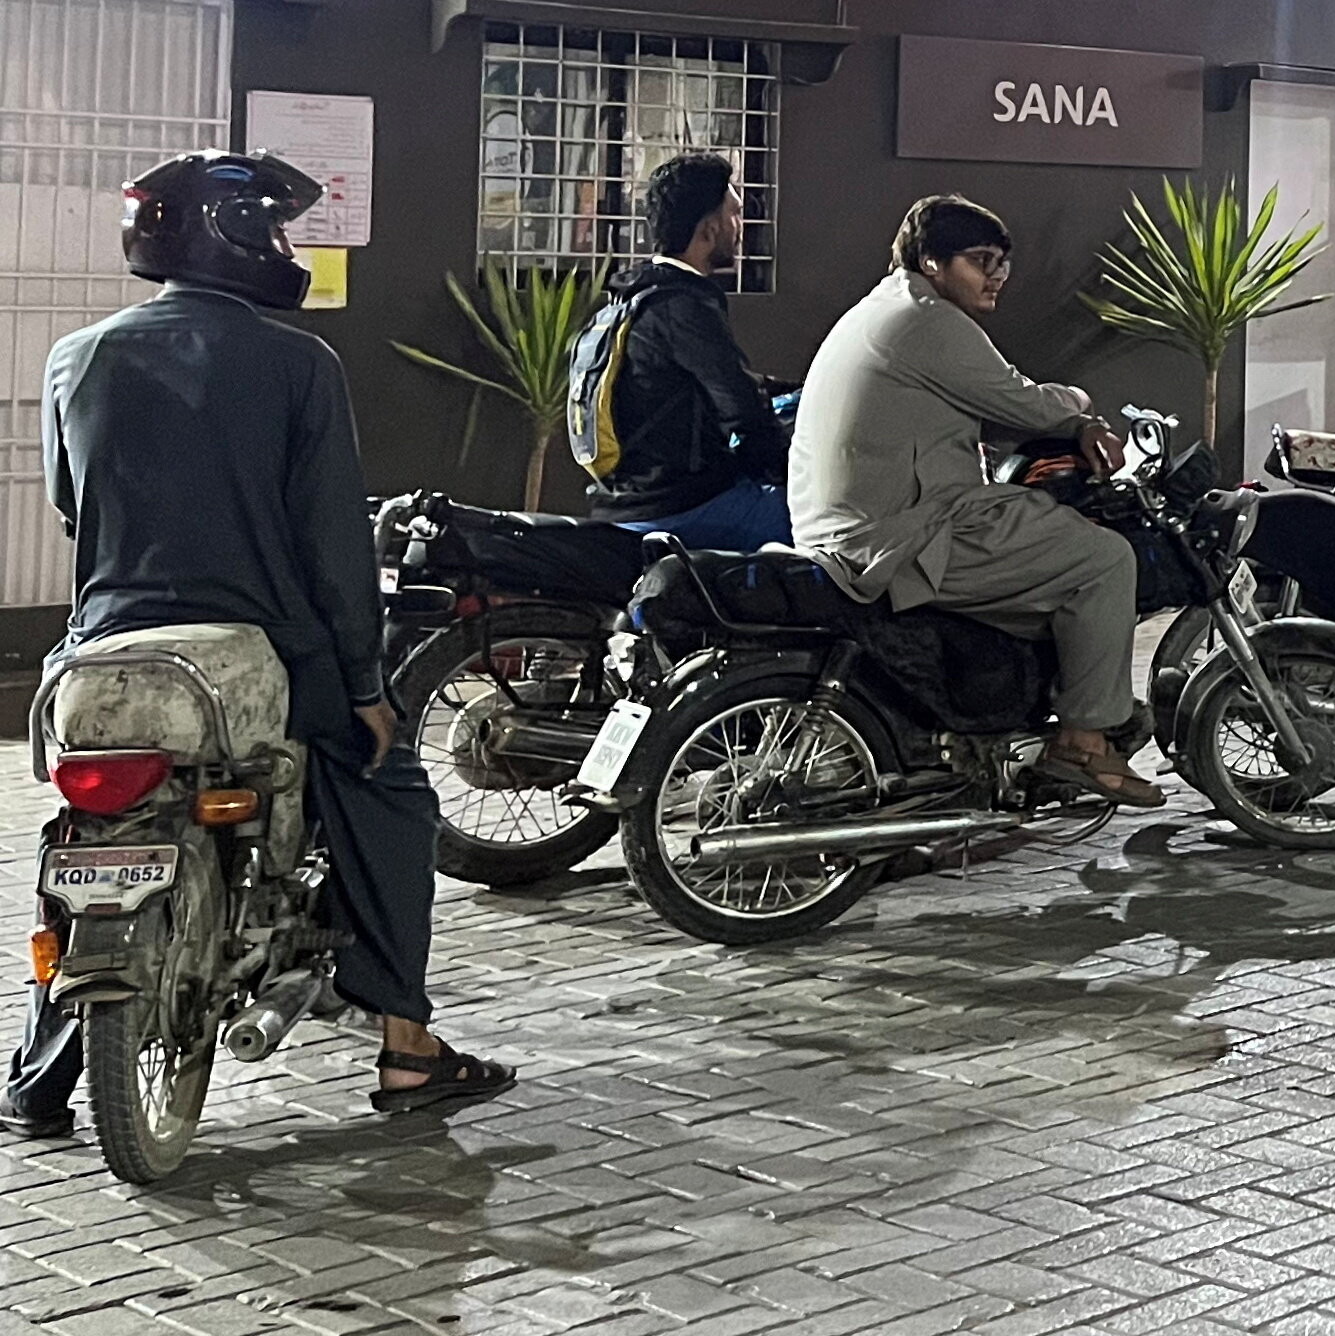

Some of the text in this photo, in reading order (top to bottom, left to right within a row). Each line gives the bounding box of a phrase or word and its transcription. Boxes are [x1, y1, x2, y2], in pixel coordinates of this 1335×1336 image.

[993, 80, 1119, 128] SANA
[54, 866, 165, 886] KQD 0652
